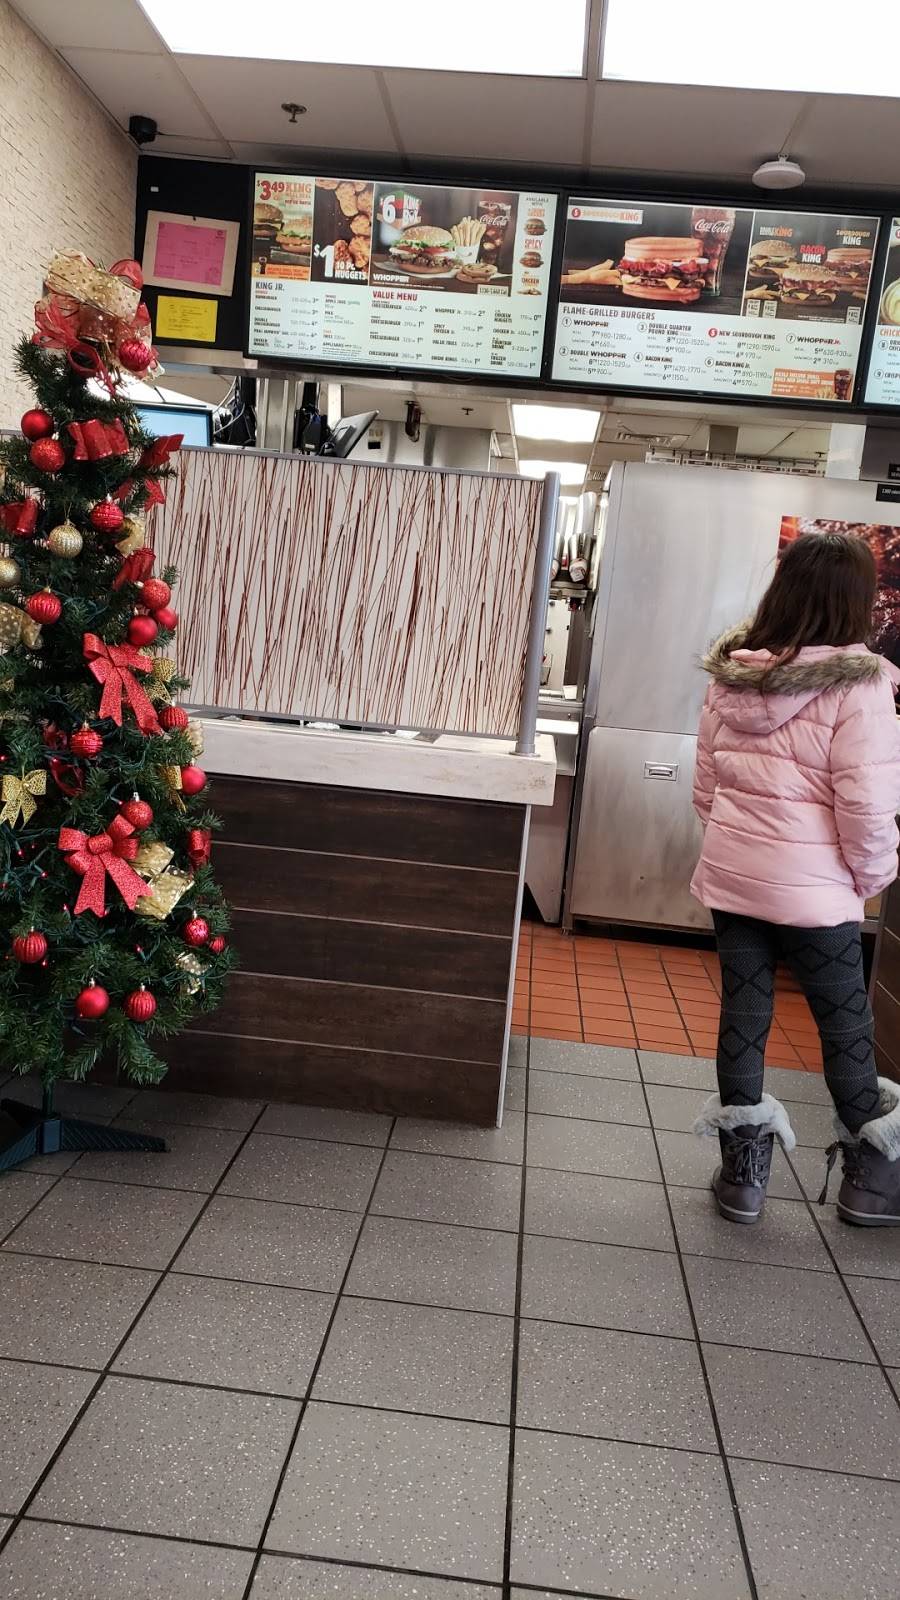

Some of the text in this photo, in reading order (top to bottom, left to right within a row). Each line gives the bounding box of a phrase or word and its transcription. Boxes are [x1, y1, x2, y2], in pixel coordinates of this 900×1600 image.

[620, 211, 639, 222] KING
[694, 218, 730, 233] Coca-Cola
[842, 236, 861, 246] KING
[800, 244, 826, 255] BACON
[314, 244, 335, 277] $1
[801, 253, 822, 263] KING
[335, 270, 368, 280] NUGGETS
[256, 281, 285, 291] KING JR.
[372, 290, 418, 301] VALUE MENU
[563, 305, 656, 321] FLAME-GRILLED BURGERS
[669, 324, 692, 332] QUARTER
[732, 331, 763, 340] SOURDOUGH
[763, 333, 776, 341] KING
[591, 350, 627, 359] WHOPPER
[715, 360, 731, 368] BACON
[732, 361, 744, 369] KING
